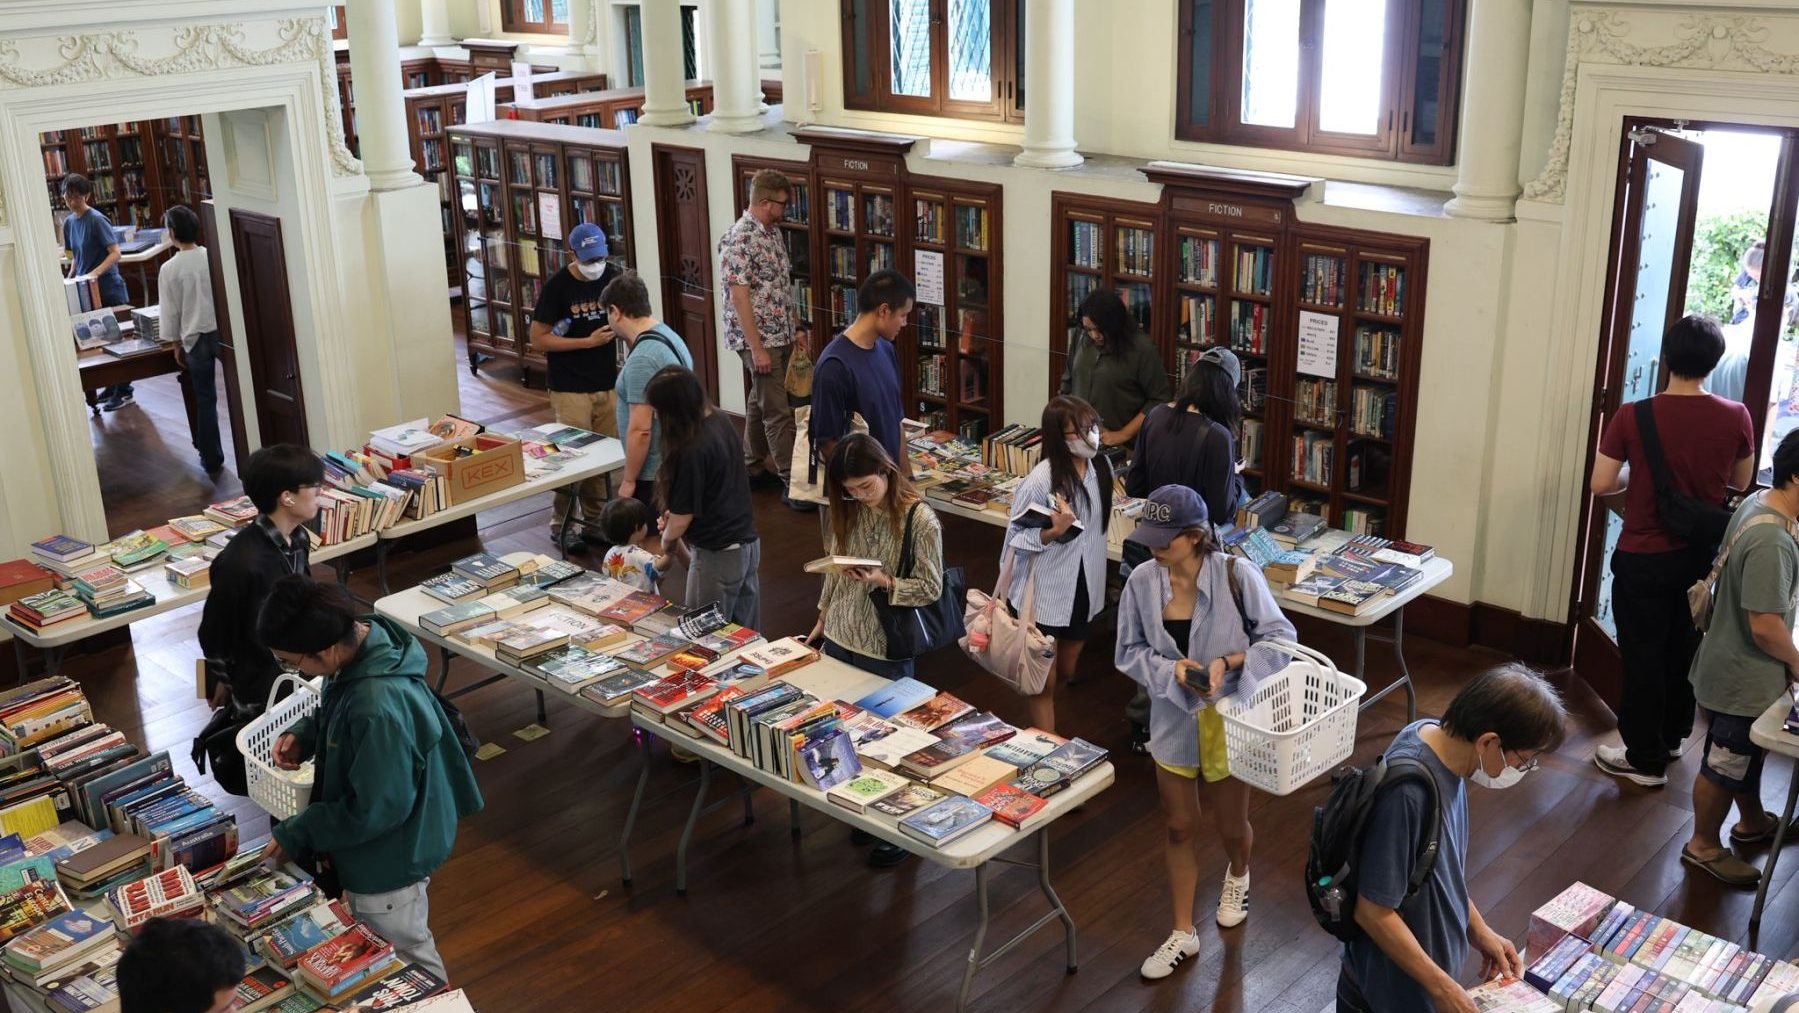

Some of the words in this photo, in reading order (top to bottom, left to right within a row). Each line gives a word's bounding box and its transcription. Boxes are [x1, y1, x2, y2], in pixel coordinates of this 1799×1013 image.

[844, 159, 868, 171] FICTION
[1208, 203, 1242, 217] FICTION
[466, 460, 509, 484] KEX
[181, 830, 214, 847] Australia
[380, 977, 422, 1002] TOWN
